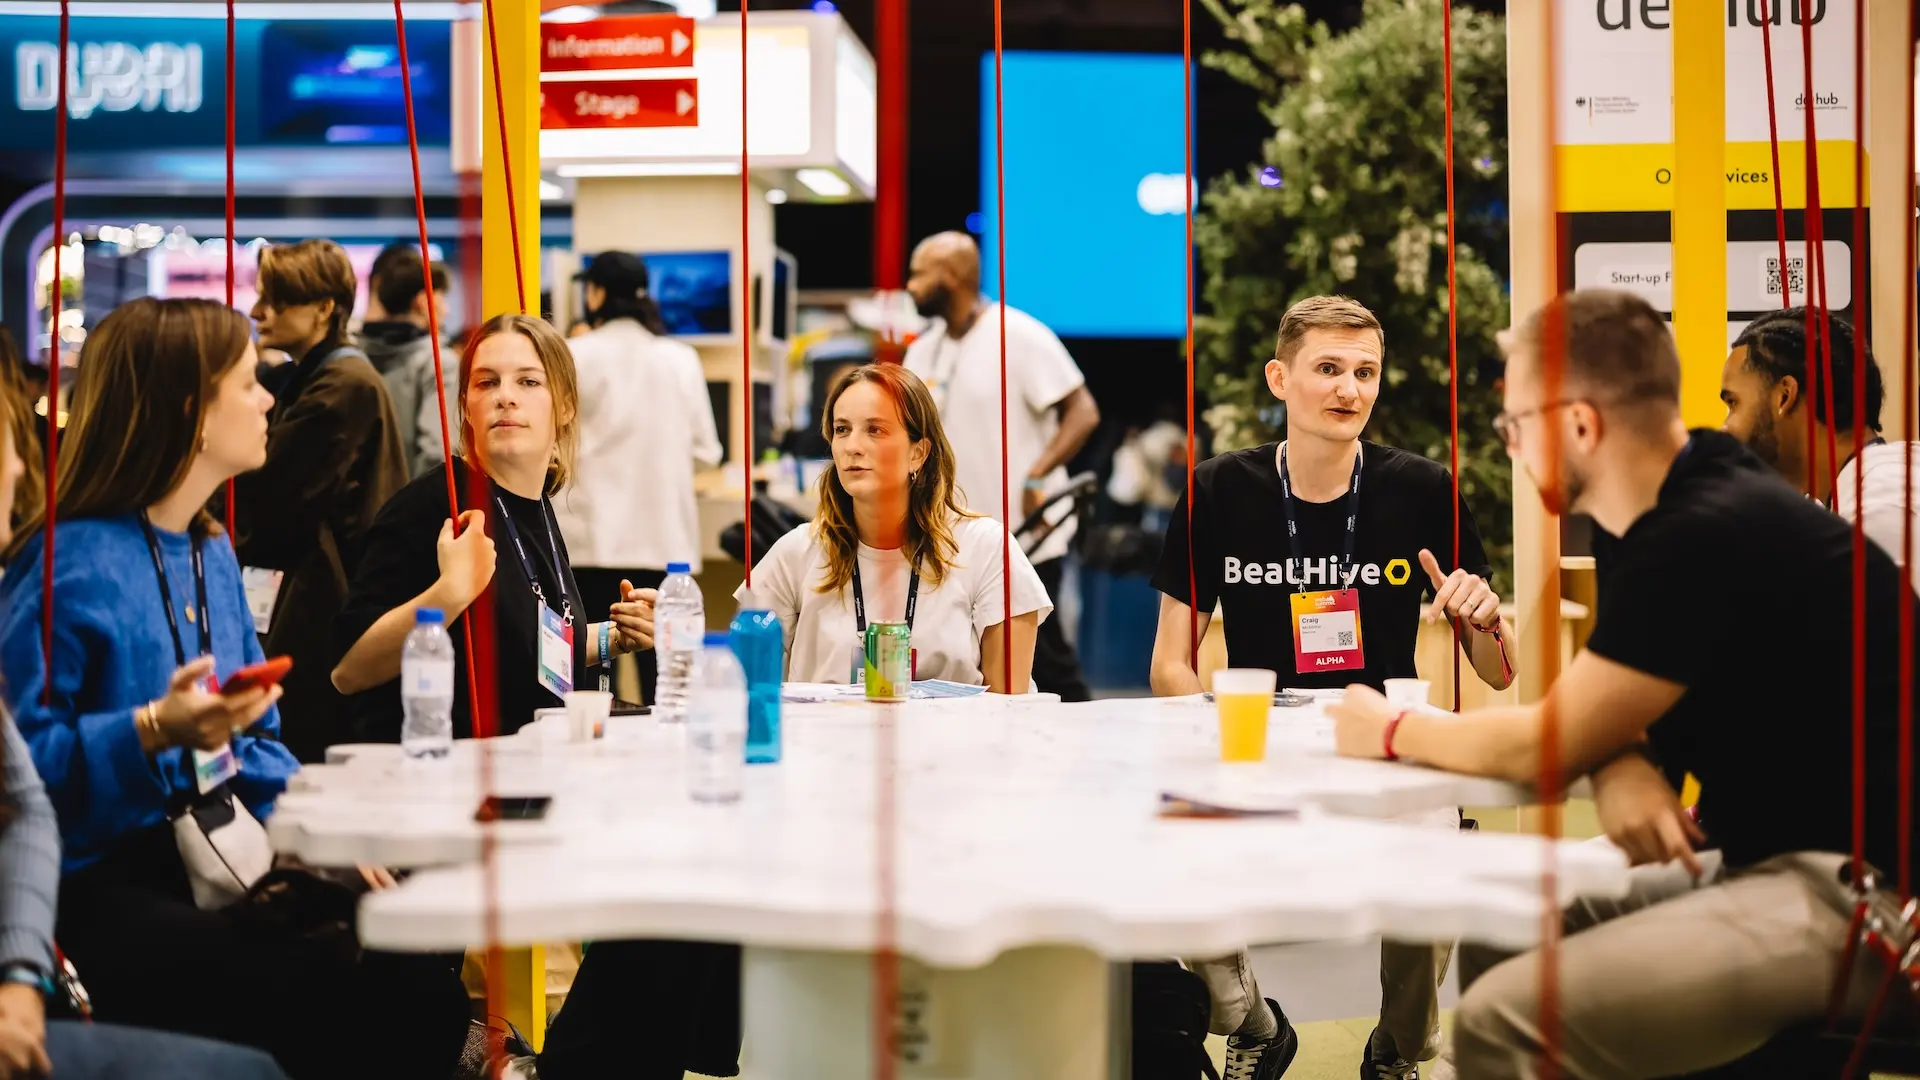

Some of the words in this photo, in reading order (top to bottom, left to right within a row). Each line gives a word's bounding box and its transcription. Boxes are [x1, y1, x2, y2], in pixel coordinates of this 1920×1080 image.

[548, 35, 665, 59] Information
[574, 90, 640, 120] Stage
[1611, 271, 1661, 285] Start-up
[1315, 656, 1345, 666] ALPHA
